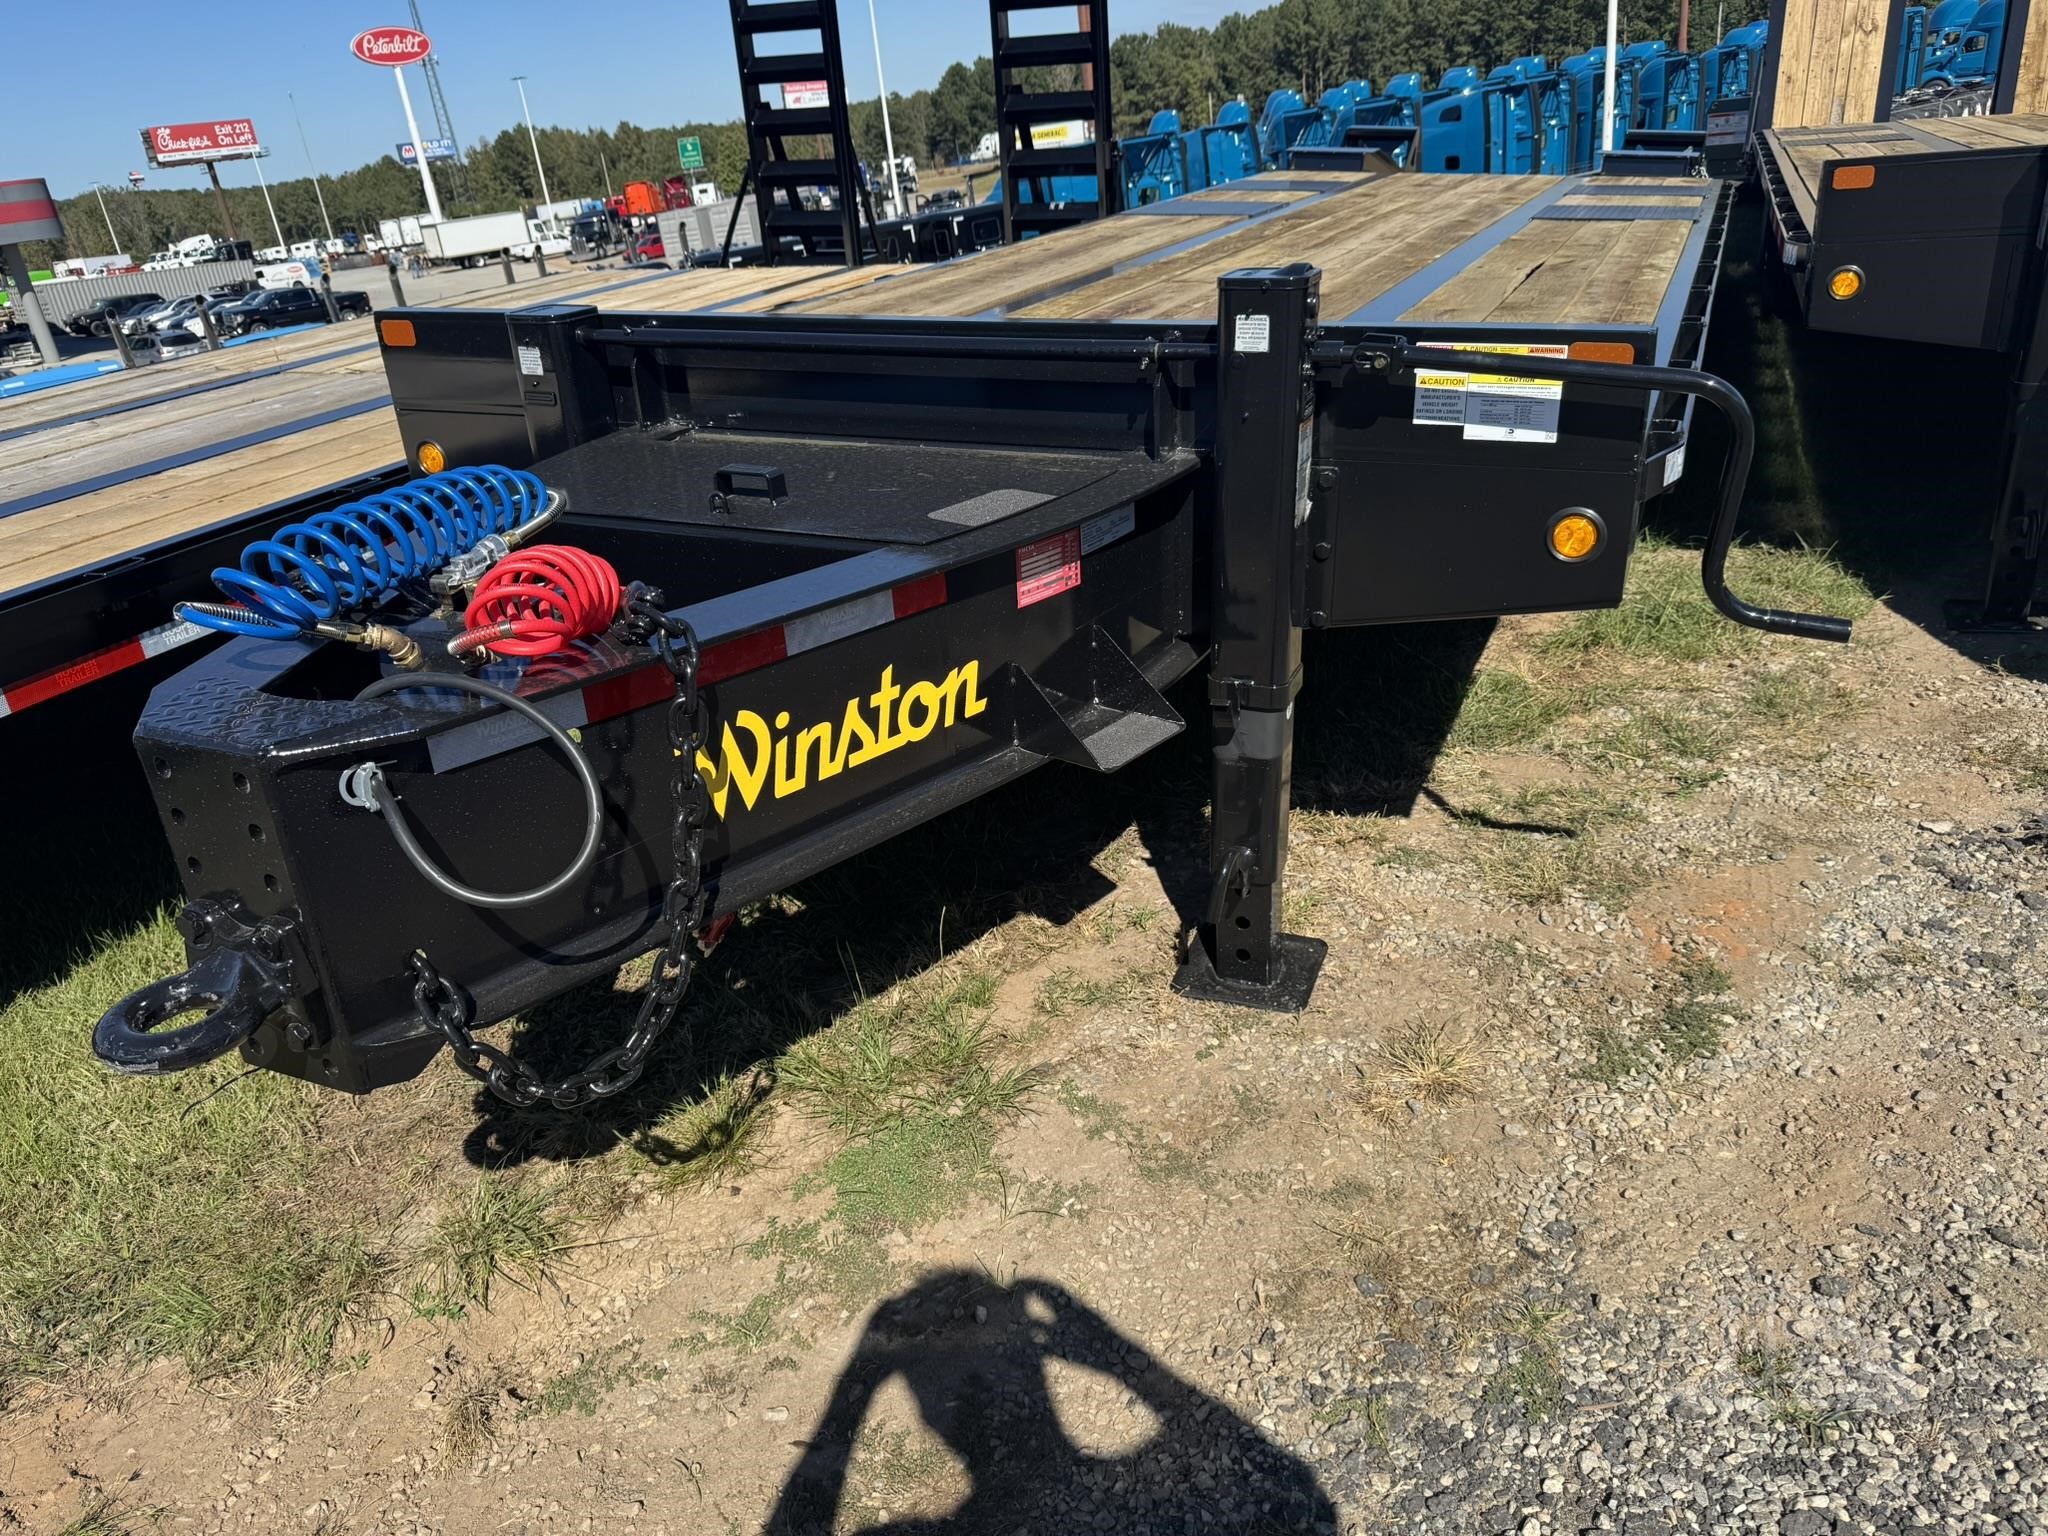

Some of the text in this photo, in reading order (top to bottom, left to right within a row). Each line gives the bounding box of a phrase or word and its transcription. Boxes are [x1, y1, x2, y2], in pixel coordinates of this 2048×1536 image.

[362, 34, 424, 57] Peterbilt
[214, 122, 250, 135] Exit 212
[218, 132, 253, 145] On Left
[1534, 346, 1564, 354] WARNING
[1427, 378, 1465, 386] CAUTION
[163, 625, 201, 645] TRAILER
[57, 665, 100, 688] TRAILER
[672, 659, 988, 823] Winston
